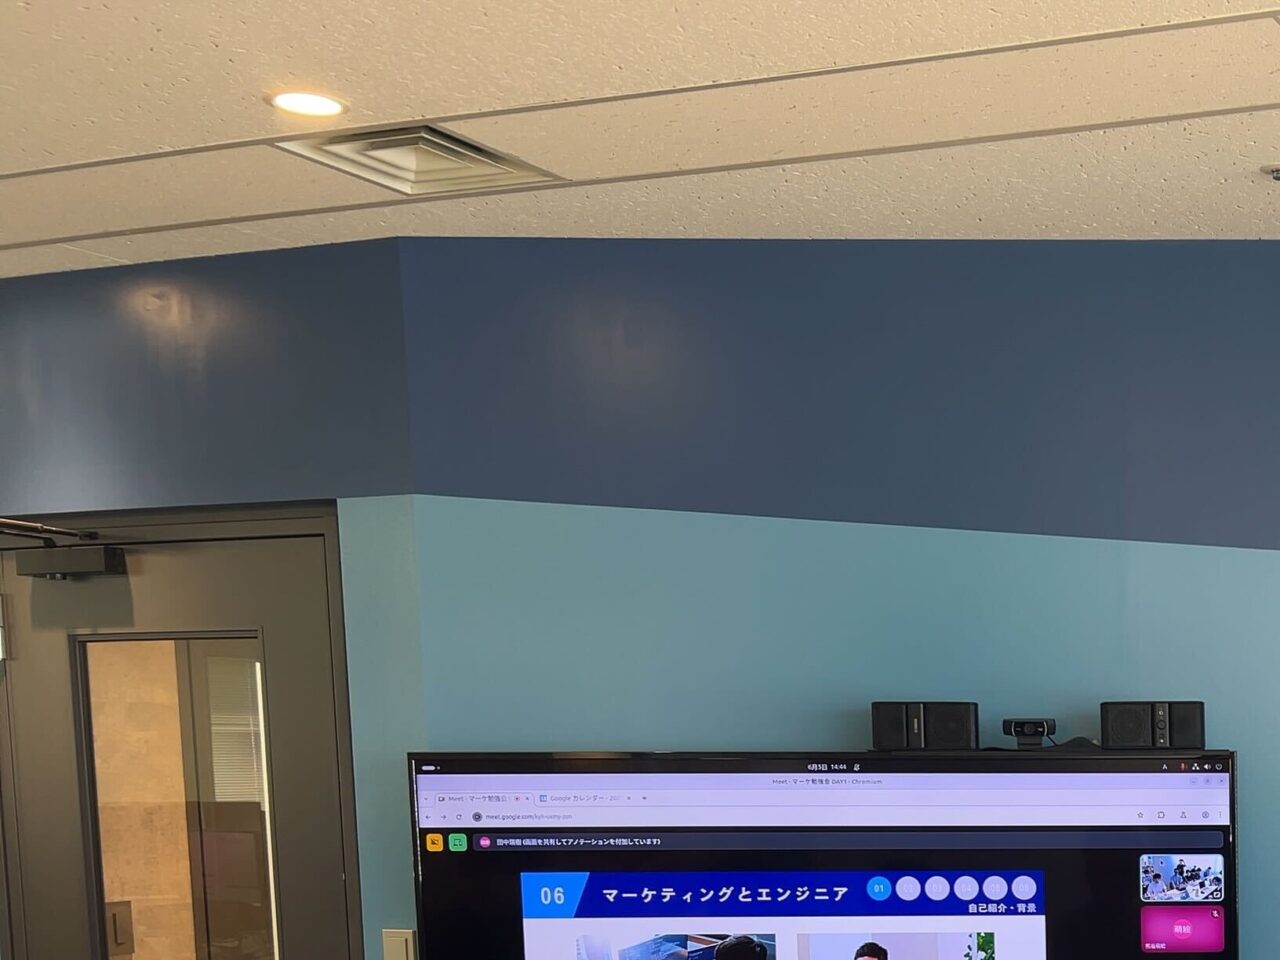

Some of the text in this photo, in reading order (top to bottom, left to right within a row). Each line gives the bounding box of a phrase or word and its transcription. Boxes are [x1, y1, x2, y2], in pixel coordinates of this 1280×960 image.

[602, 886, 848, 903] マーケティングとエンジニア
[873, 884, 884, 893] 01
[540, 886, 565, 905] 06
[968, 903, 1037, 913] 自己紹介・背景
